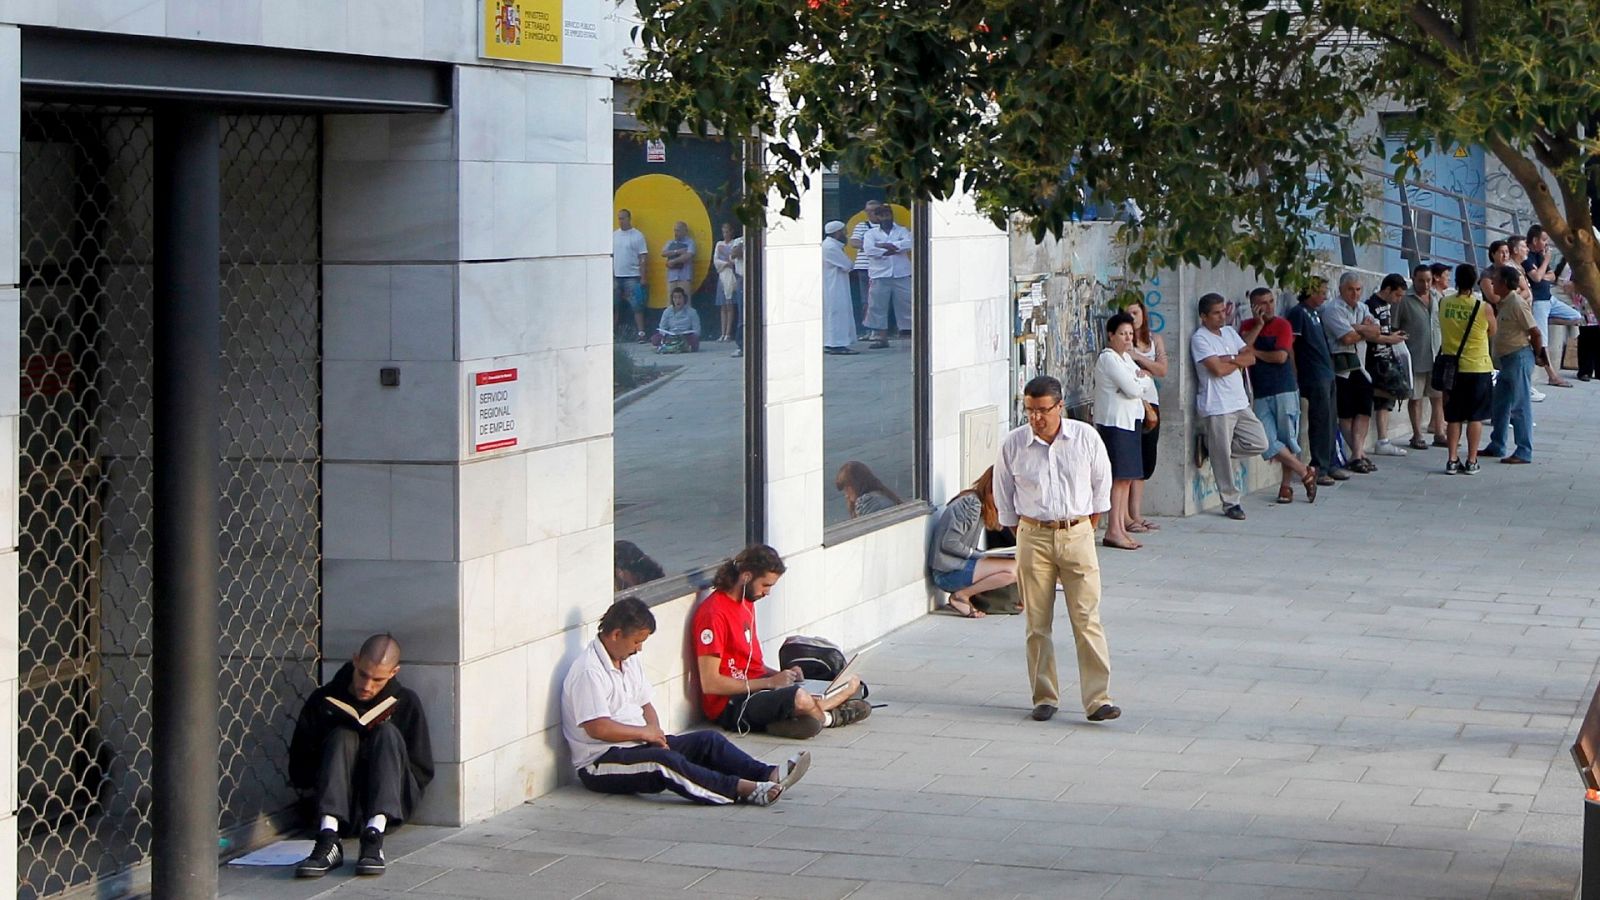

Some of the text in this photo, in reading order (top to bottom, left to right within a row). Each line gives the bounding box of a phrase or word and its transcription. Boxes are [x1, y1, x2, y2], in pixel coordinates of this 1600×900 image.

[479, 390, 508, 404] SERVICIO
[479, 405, 511, 420] REGIONAL
[479, 419, 515, 436] DE EMPLEO
